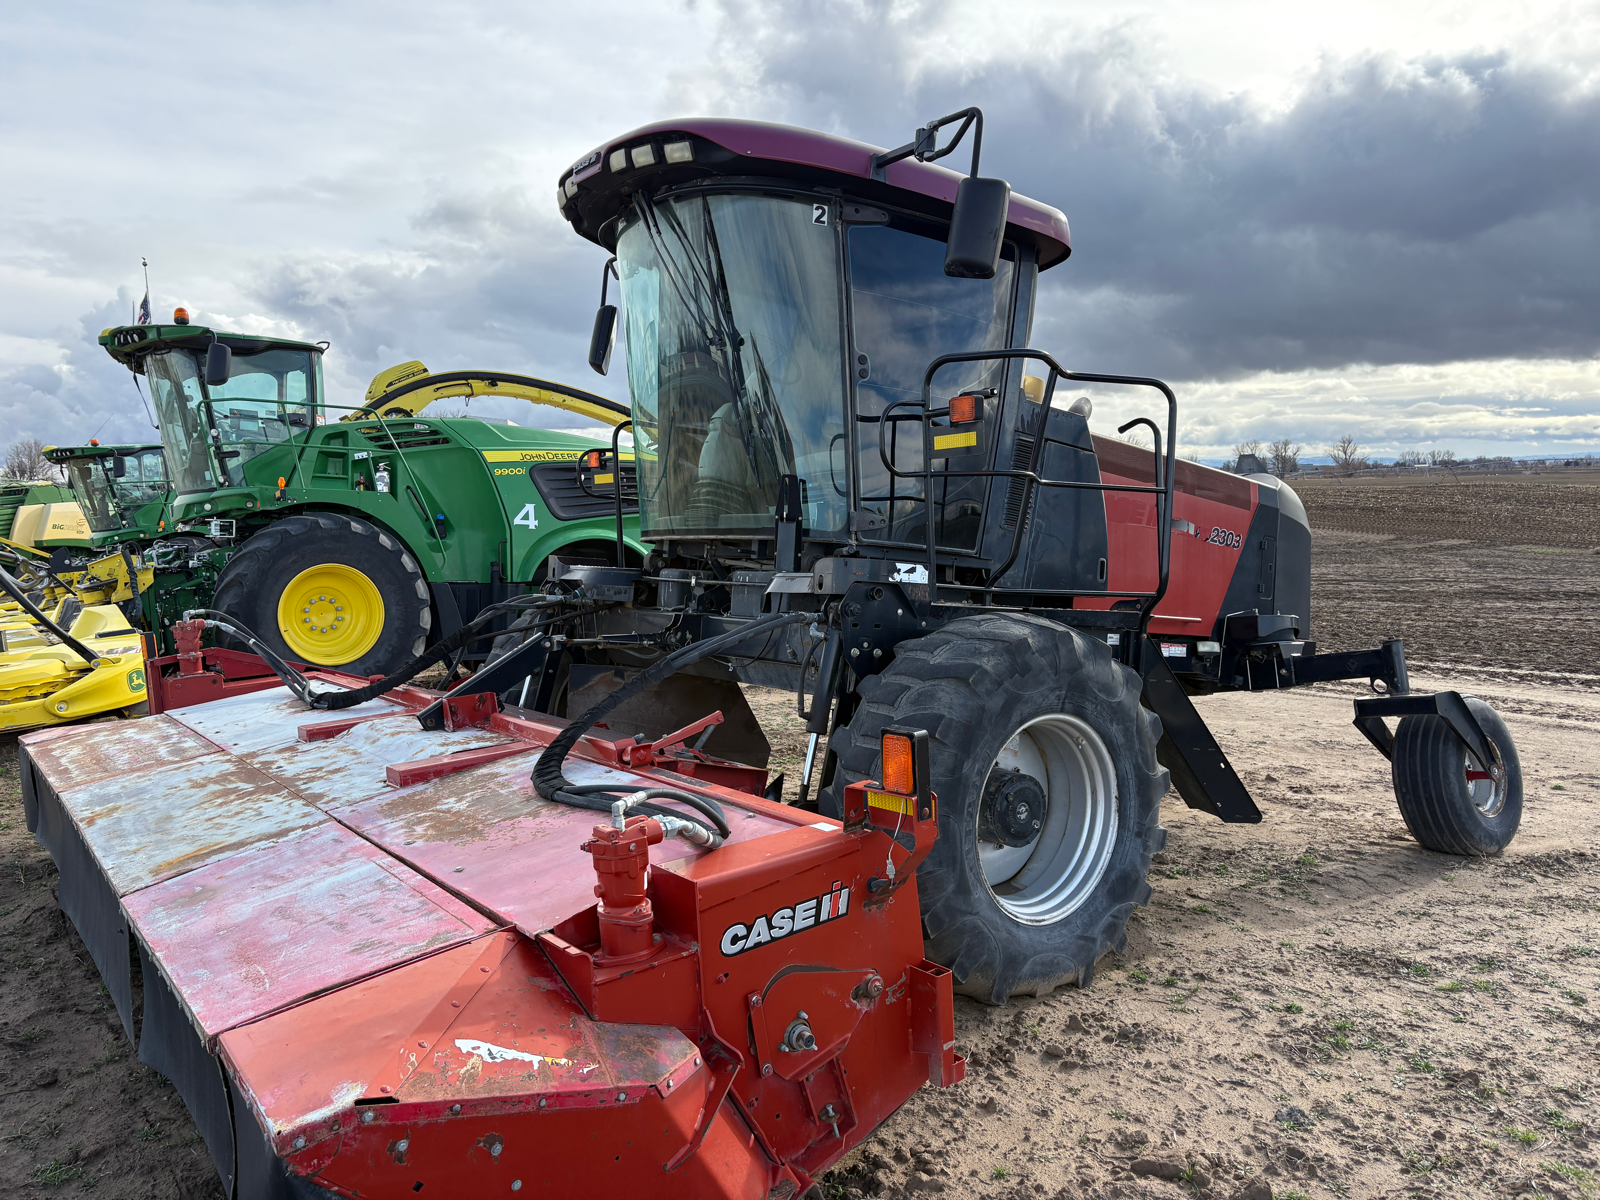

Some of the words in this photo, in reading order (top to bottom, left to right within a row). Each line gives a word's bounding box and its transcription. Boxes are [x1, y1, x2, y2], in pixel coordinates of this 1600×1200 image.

[813, 205, 826, 225] 2
[546, 451, 580, 461] DEERE
[493, 466, 526, 476] 9900i
[513, 503, 539, 530] 4
[1209, 526, 1242, 550] 2303
[721, 898, 818, 955] CASE
